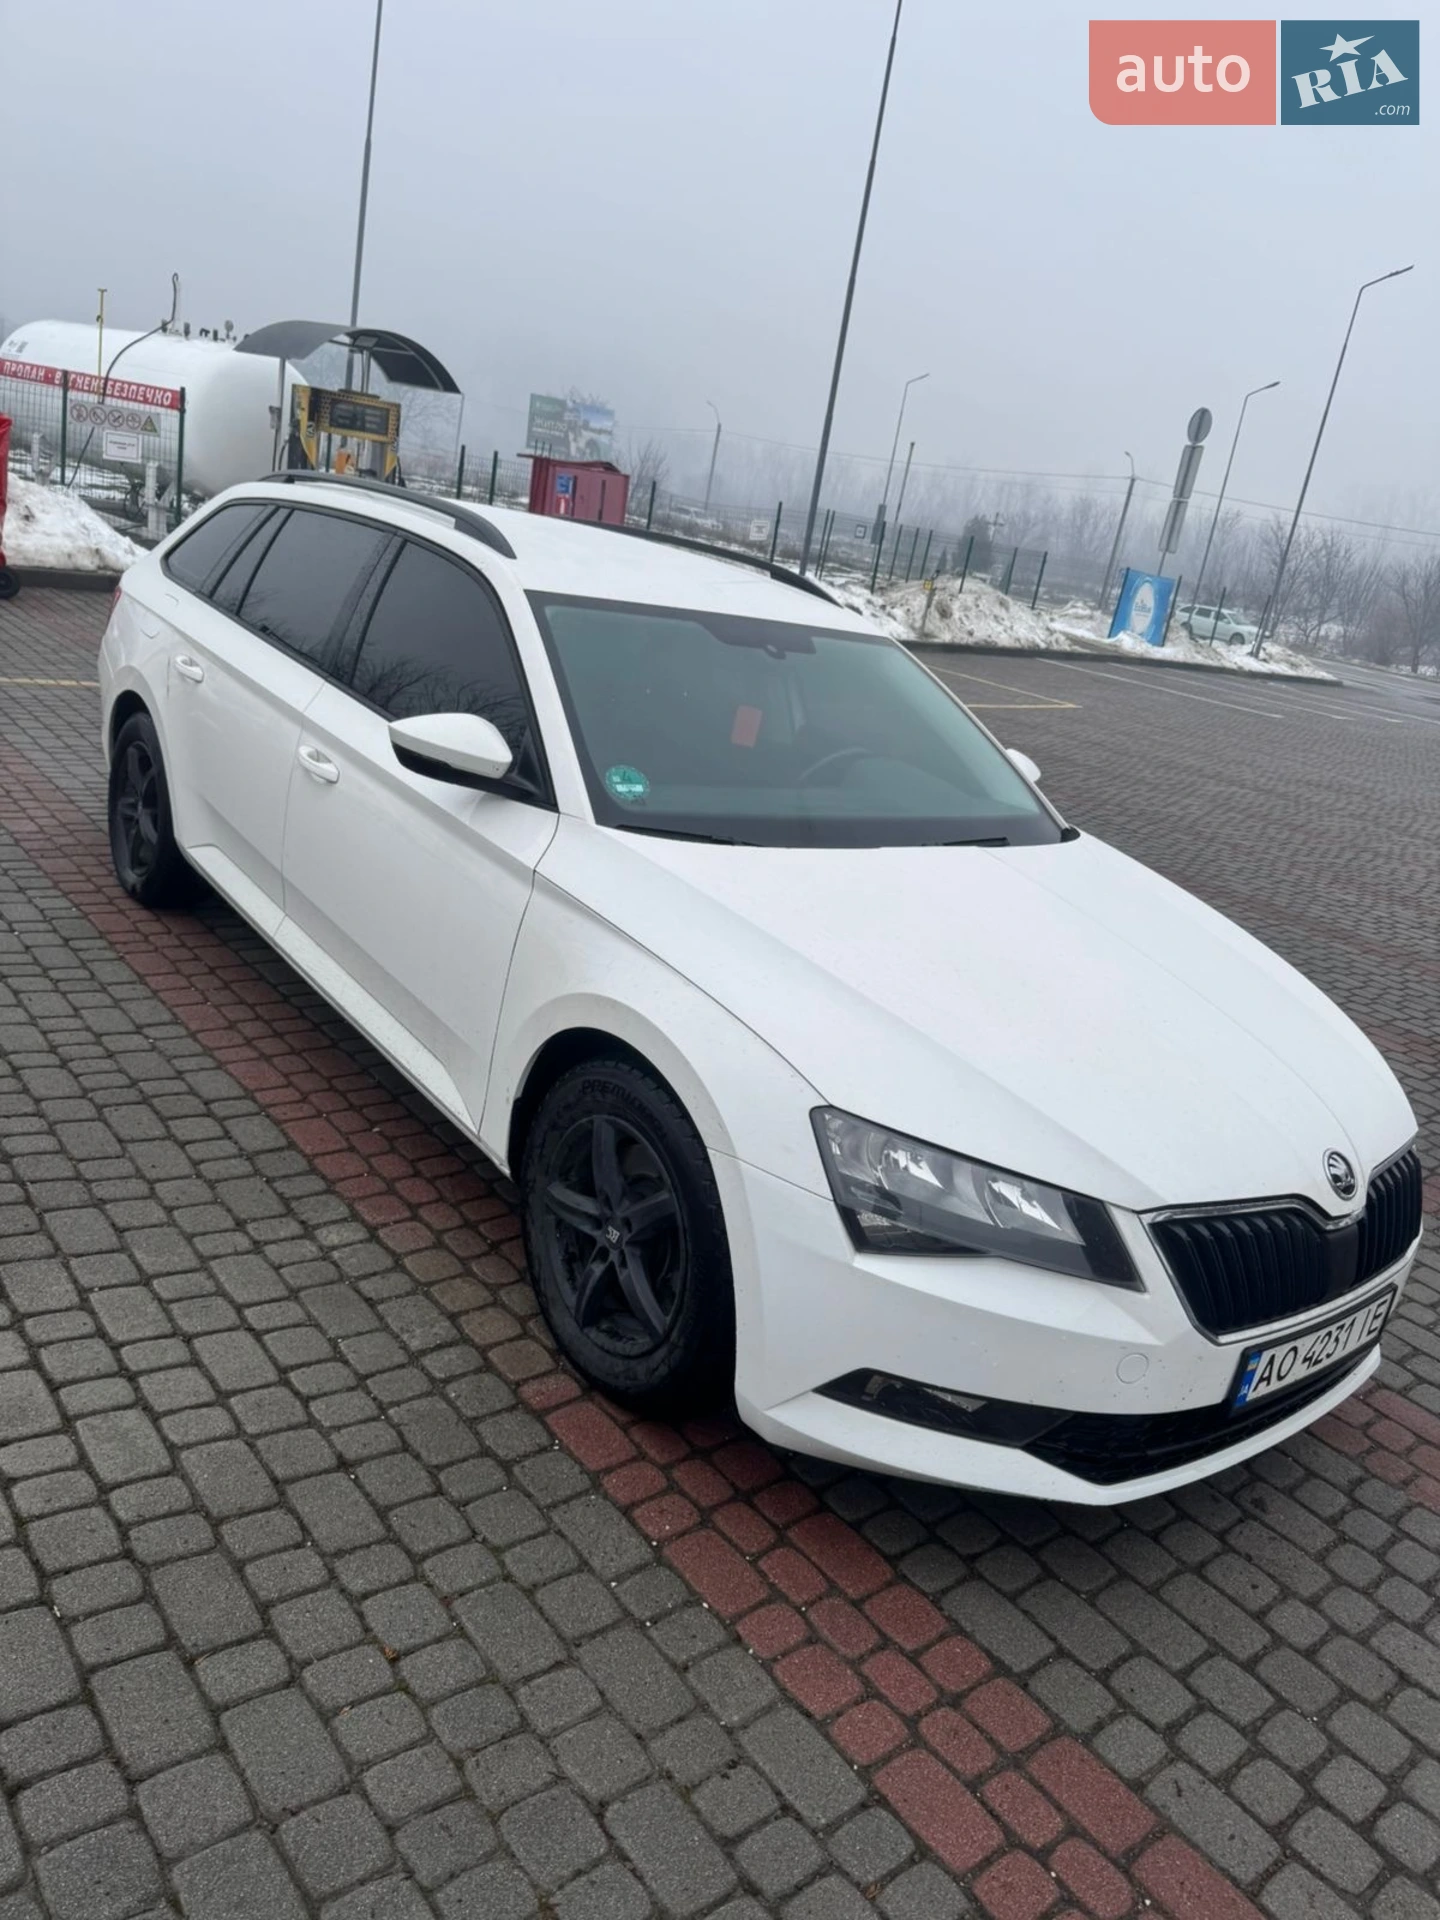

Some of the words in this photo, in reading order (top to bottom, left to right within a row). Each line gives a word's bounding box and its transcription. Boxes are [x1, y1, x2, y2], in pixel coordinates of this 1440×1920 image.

[3, 361, 46, 381] ПРОПАН
[1252, 1345, 1299, 1392] AO
[1301, 1316, 1357, 1370] 4231
[1357, 1298, 1388, 1343] IE
